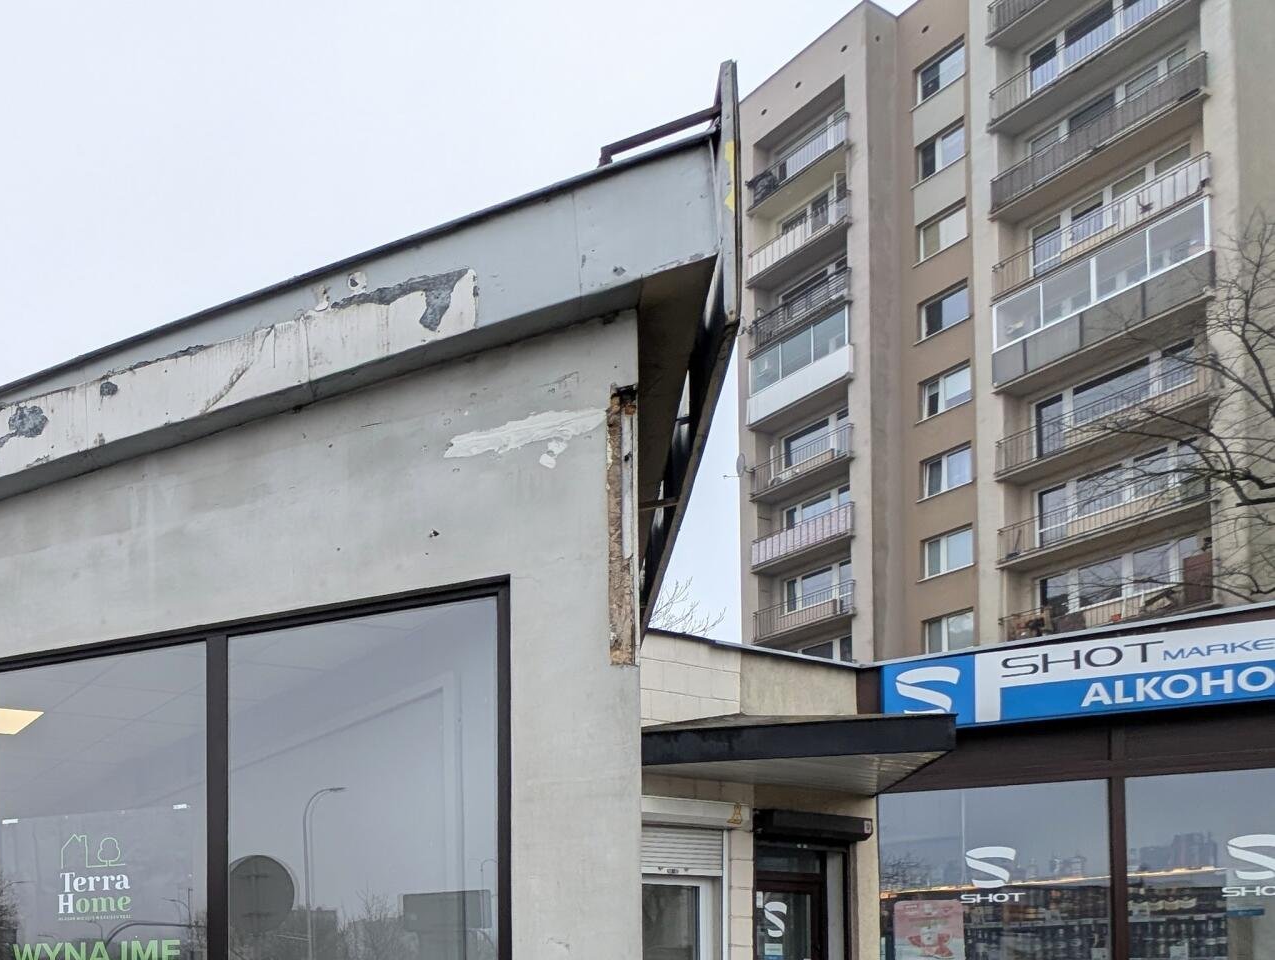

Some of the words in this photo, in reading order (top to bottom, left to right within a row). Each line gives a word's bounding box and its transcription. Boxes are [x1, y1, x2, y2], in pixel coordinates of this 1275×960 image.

[1001, 640, 1163, 678] SHOT
[59, 871, 131, 894] Terra
[57, 893, 132, 914] Home
[960, 892, 1026, 904] SHOT
